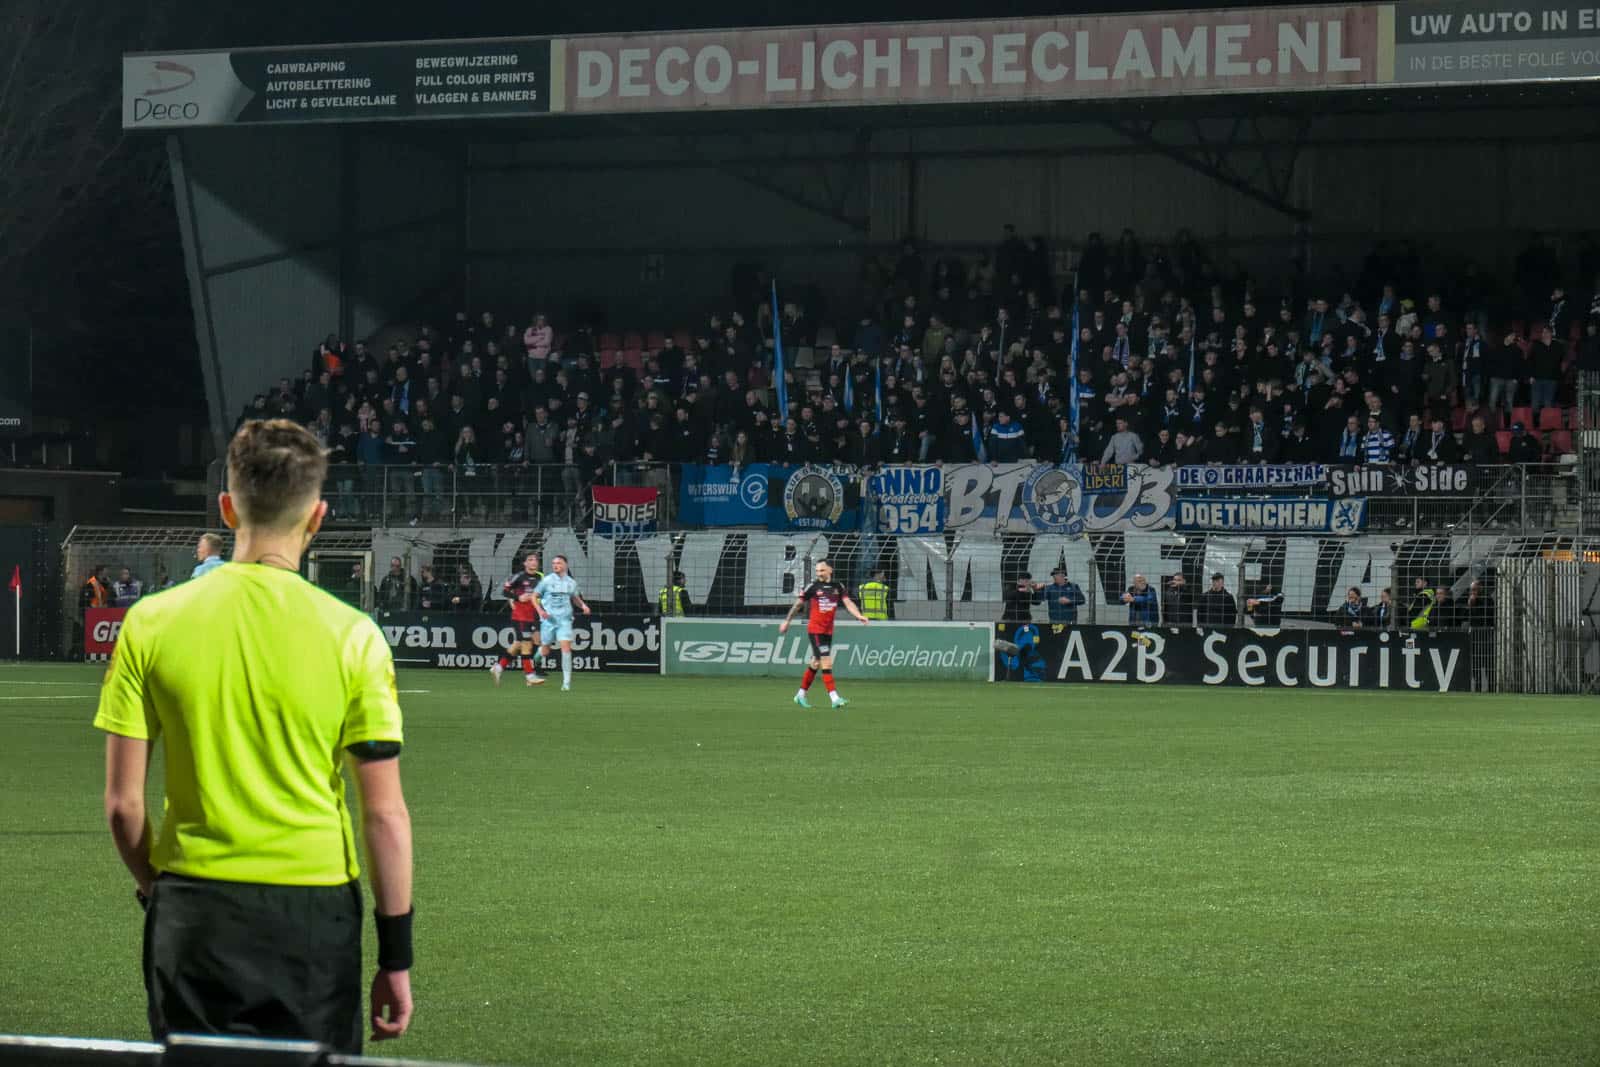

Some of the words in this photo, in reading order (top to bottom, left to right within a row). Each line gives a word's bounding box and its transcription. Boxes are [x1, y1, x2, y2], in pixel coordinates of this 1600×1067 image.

[1410, 14, 1452, 36] UW
[1460, 11, 1532, 34] AUTO
[1542, 9, 1568, 31] IN
[266, 61, 346, 75] CARWRAPPING
[415, 54, 519, 69] BEWEGWIJZERING
[576, 20, 1361, 98] DECO-LICHTRECLAME.NL
[1410, 55, 1427, 71] IN
[1432, 54, 1453, 70] DE
[1459, 53, 1513, 70] BESTE
[1518, 51, 1567, 67] FOLIE
[266, 77, 372, 92] AUTOBELETTERING
[415, 74, 444, 87] FULL
[446, 72, 492, 86] COLOUR
[494, 71, 536, 84] PRINTS
[265, 96, 298, 110] LICHT
[310, 93, 398, 109] GEVELRECLAME
[415, 91, 469, 105] VLAGGEN
[471, 91, 479, 103] &
[483, 89, 538, 103] BANNERS
[134, 98, 200, 122] Deco
[1180, 468, 1199, 484] DE
[1331, 466, 1384, 496] Spin
[1415, 465, 1467, 492] Side
[594, 501, 656, 522] OLDIES
[879, 504, 939, 533] 954
[1181, 502, 1328, 530] DOETINCHEM
[382, 625, 457, 649] van
[472, 622, 661, 652] oochot
[727, 635, 850, 664] sallr
[848, 643, 983, 669] Nederland.nl
[1056, 629, 1167, 684] A2B
[1202, 629, 1462, 693] Security
[572, 656, 601, 670] 911
